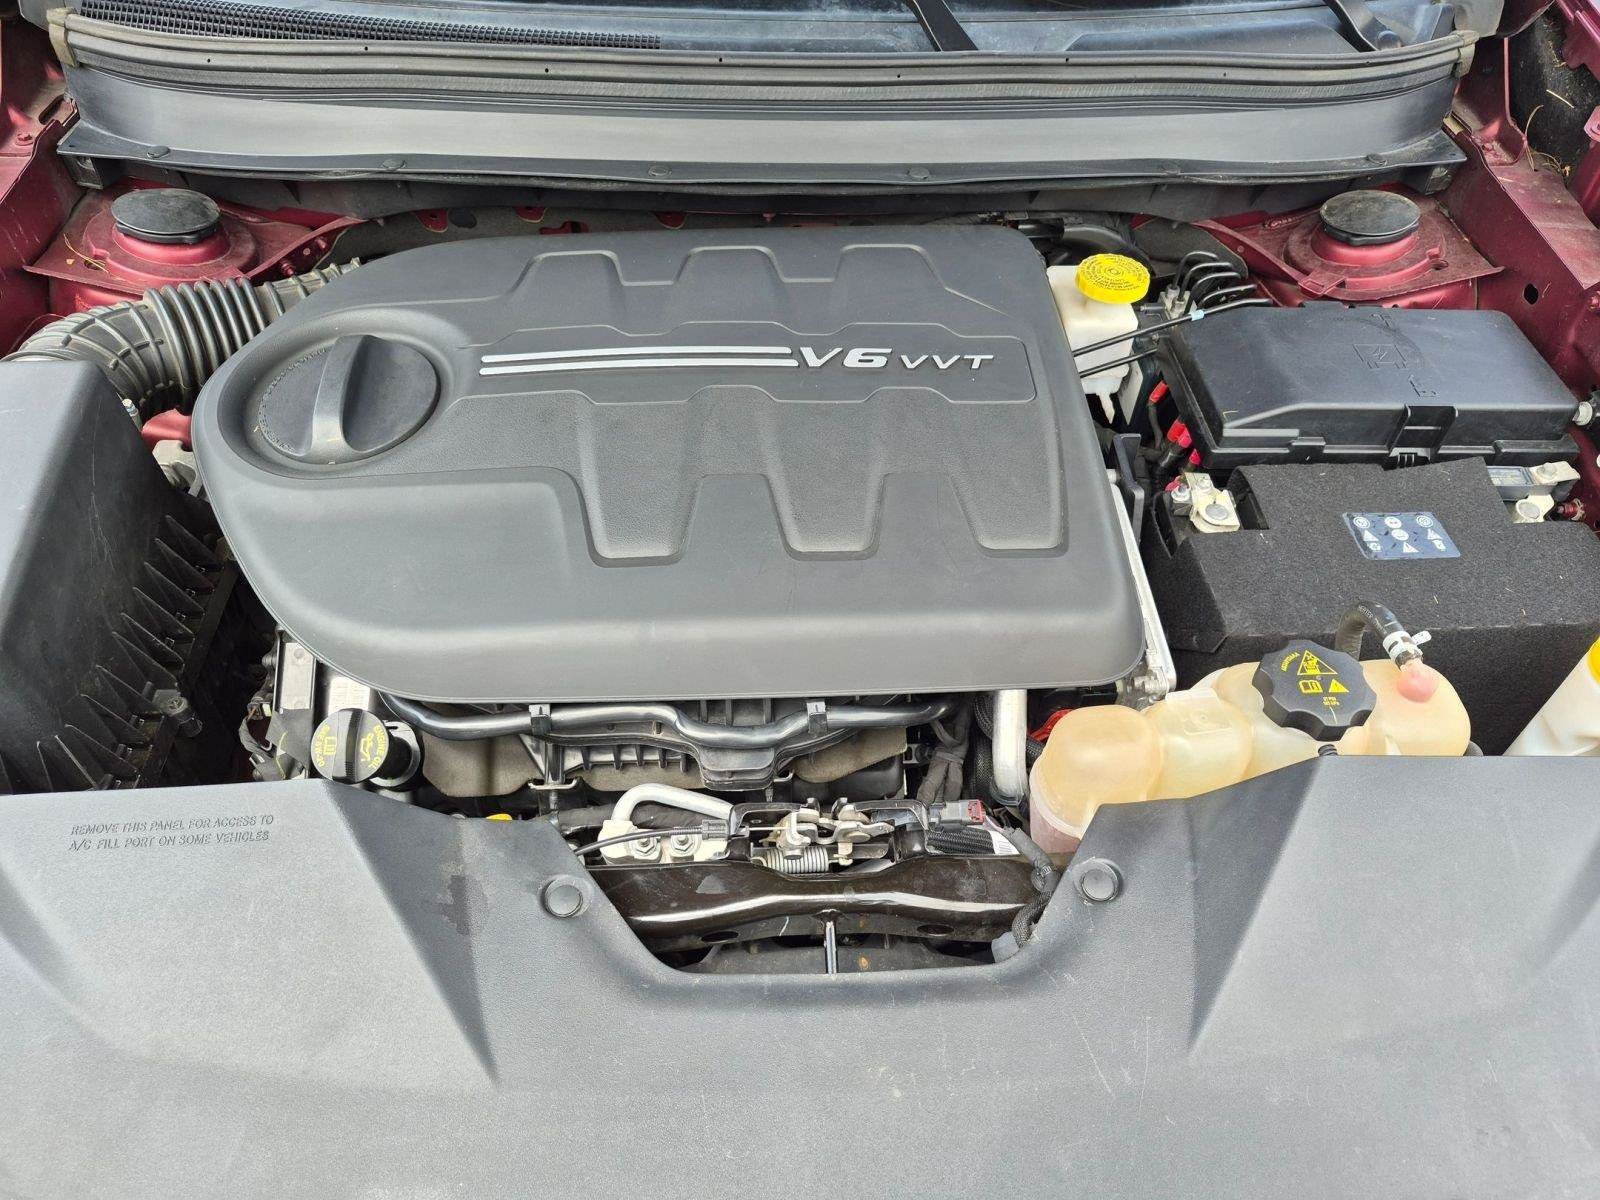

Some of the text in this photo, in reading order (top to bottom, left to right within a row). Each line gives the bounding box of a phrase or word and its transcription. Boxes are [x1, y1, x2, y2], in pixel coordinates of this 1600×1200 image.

[799, 346, 994, 370] V6 VVT
[368, 724, 387, 769] ENGINE OIL
[70, 814, 274, 836] REMOVE THIS PANEL FOR ACCESS TO
[68, 830, 270, 852] A/C FILL PORT ON SOME VEHICLES
